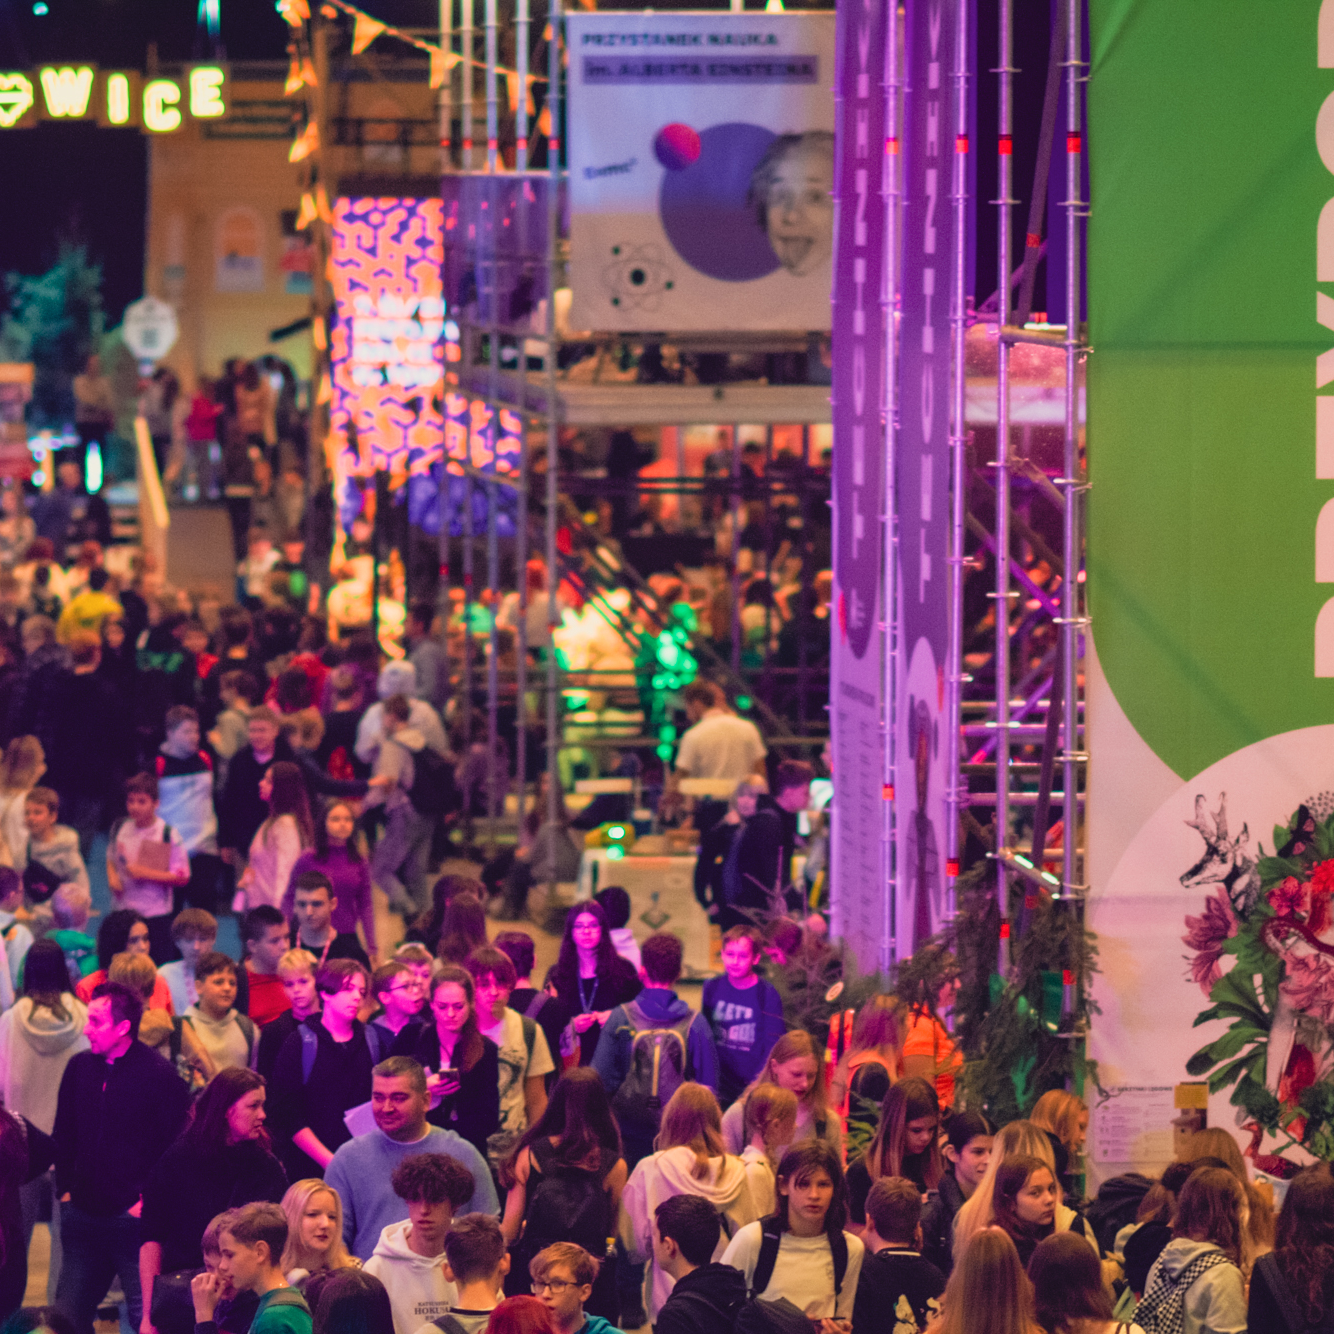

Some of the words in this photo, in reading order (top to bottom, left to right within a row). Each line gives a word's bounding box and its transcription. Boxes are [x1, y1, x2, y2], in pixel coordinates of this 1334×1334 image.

[581, 32, 702, 46] PRZYSTANEK
[707, 32, 779, 47] NAUKA
[851, 0, 873, 560] TECHNIK
